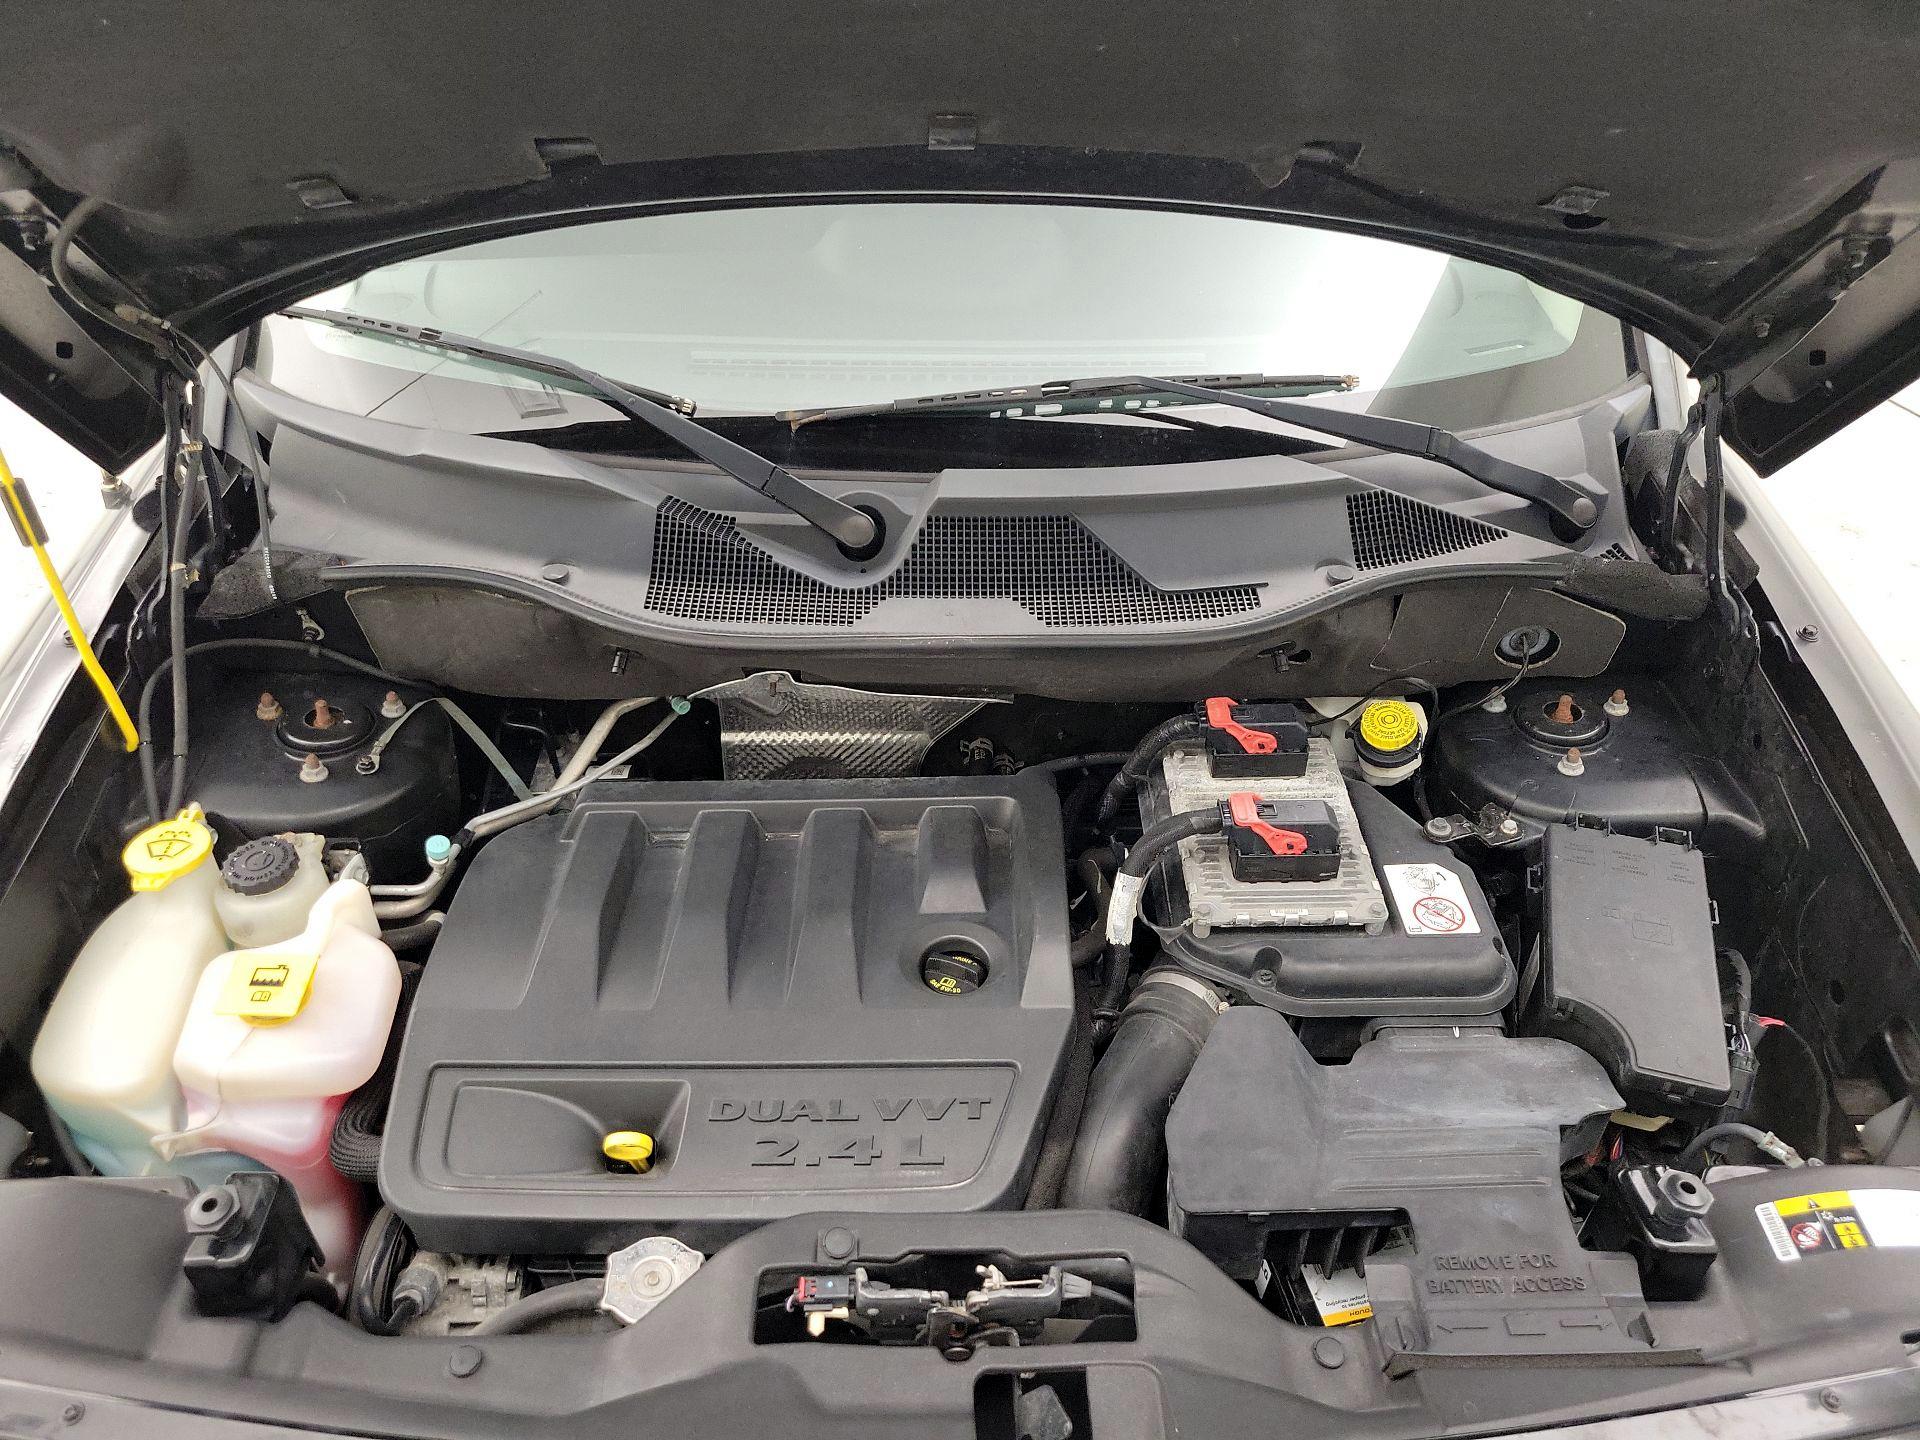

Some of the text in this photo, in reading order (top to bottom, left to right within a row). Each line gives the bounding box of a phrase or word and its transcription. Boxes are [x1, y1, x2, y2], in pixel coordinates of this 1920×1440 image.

[708, 1097, 991, 1123] DUAL VVT
[1434, 1253, 1558, 1271] REMOVE FOR
[1426, 1276, 1587, 1294] BATTERY ACCESS
